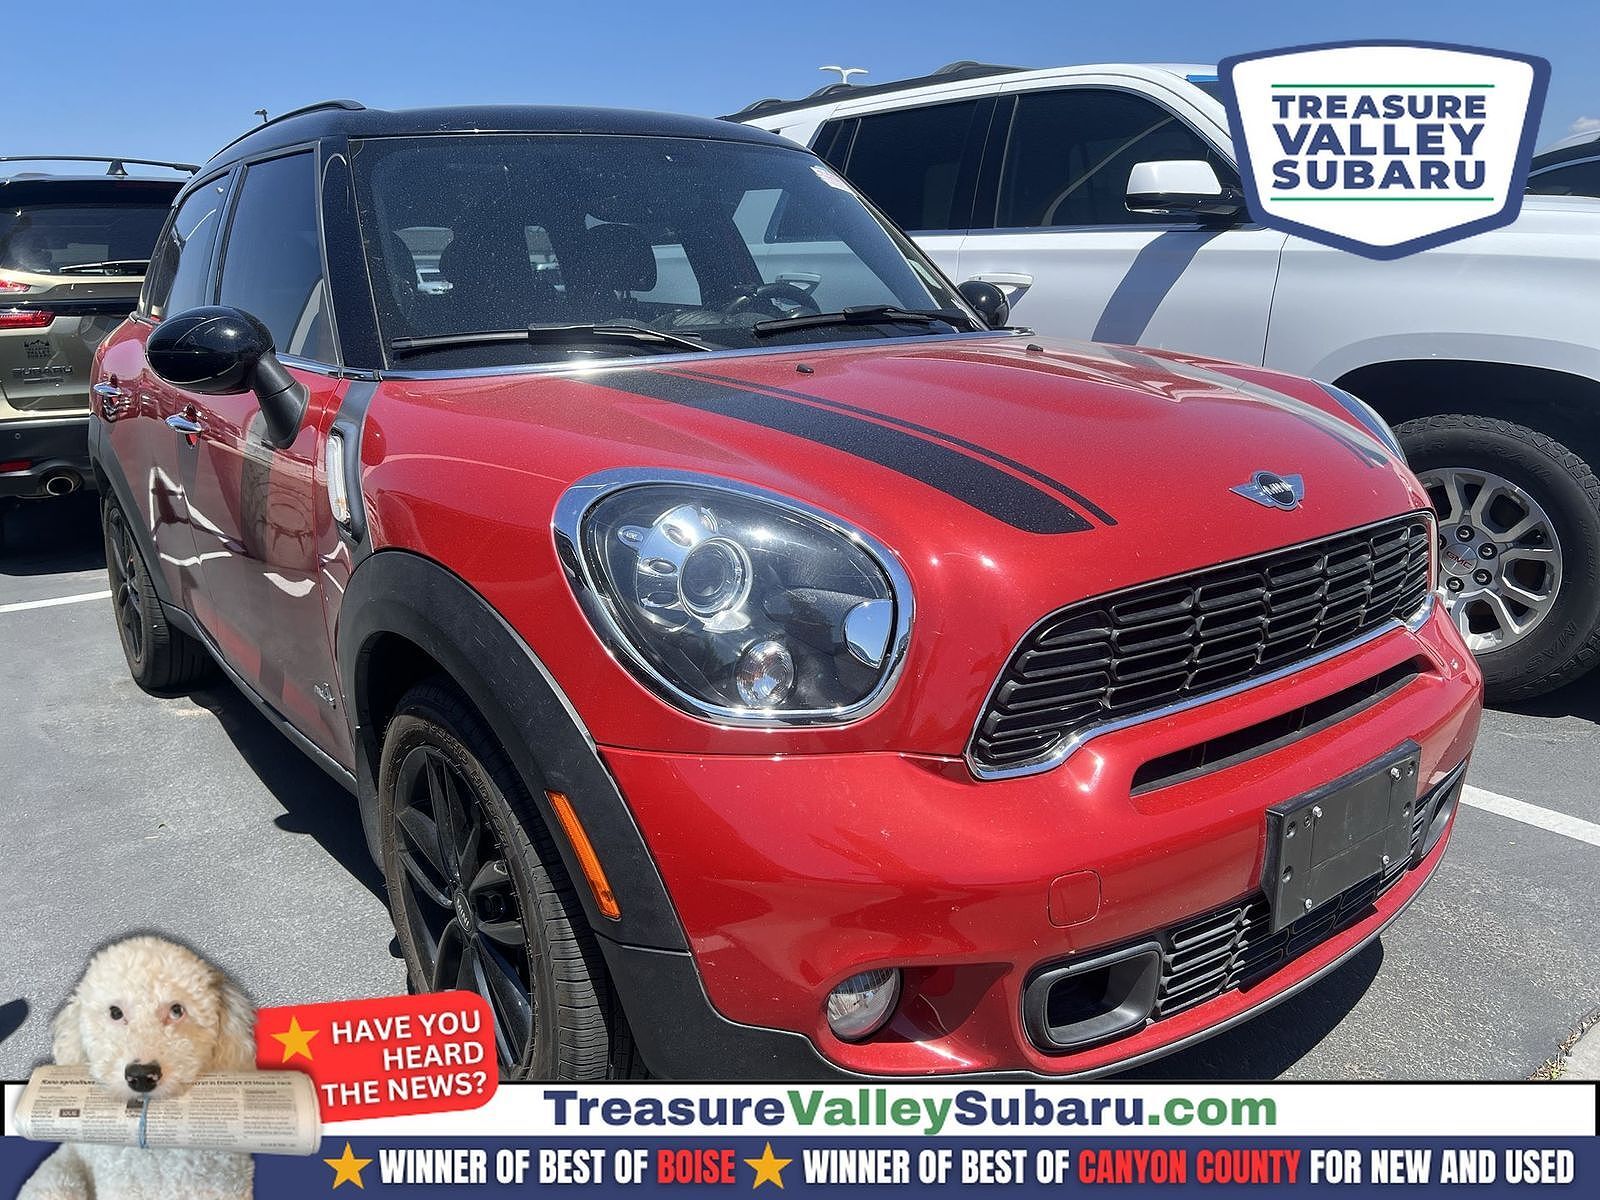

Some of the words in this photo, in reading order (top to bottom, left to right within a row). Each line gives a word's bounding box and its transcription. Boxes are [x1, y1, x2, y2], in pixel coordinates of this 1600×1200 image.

[12, 365, 73, 377] SUBARU
[1446, 551, 1473, 570] GMC
[456, 898, 470, 927] MINI
